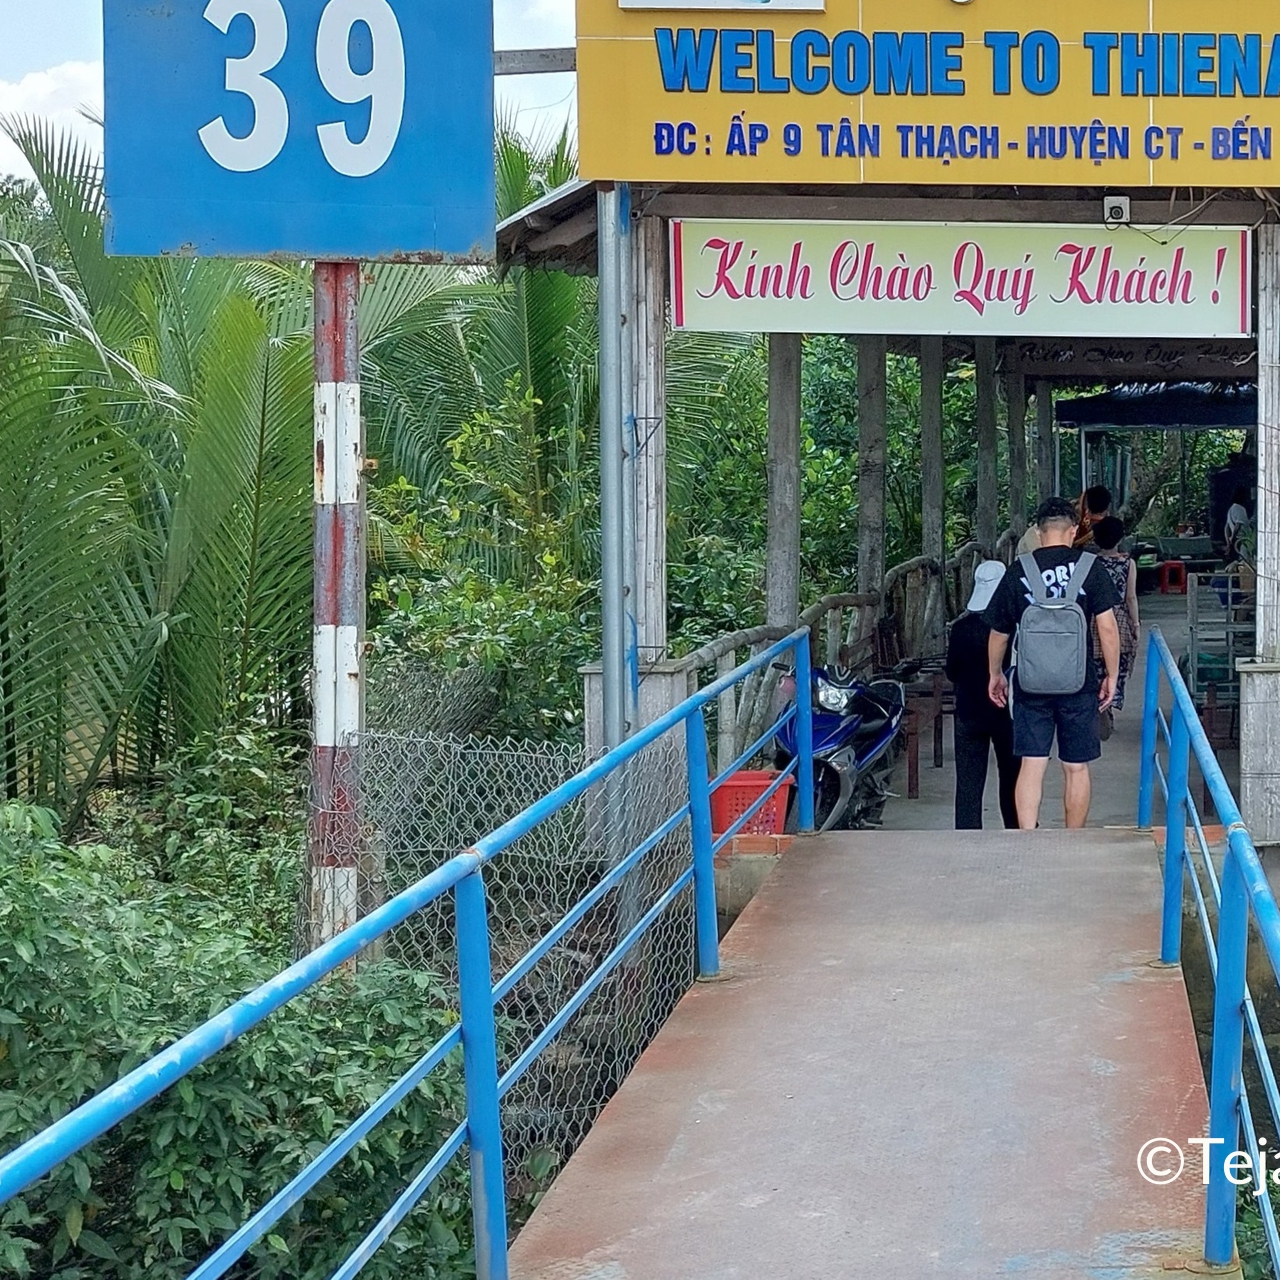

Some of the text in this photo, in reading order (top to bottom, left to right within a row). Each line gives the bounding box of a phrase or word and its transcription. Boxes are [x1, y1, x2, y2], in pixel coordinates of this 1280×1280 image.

[654, 28, 965, 96] WELCOME
[984, 30, 1060, 97] TO
[725, 110, 769, 156] ẤP
[783, 123, 802, 156] 9
[816, 117, 880, 158] TÂN
[896, 124, 1000, 166] THẠCH
[1027, 119, 1129, 166] HUYỆN
[1144, 125, 1184, 160] CT
[1211, 114, 1272, 160] BẾN
[696, 238, 815, 300] Kính
[829, 240, 937, 301] Chào
[953, 241, 1037, 316] Quý
[1049, 243, 1196, 304] Khách
